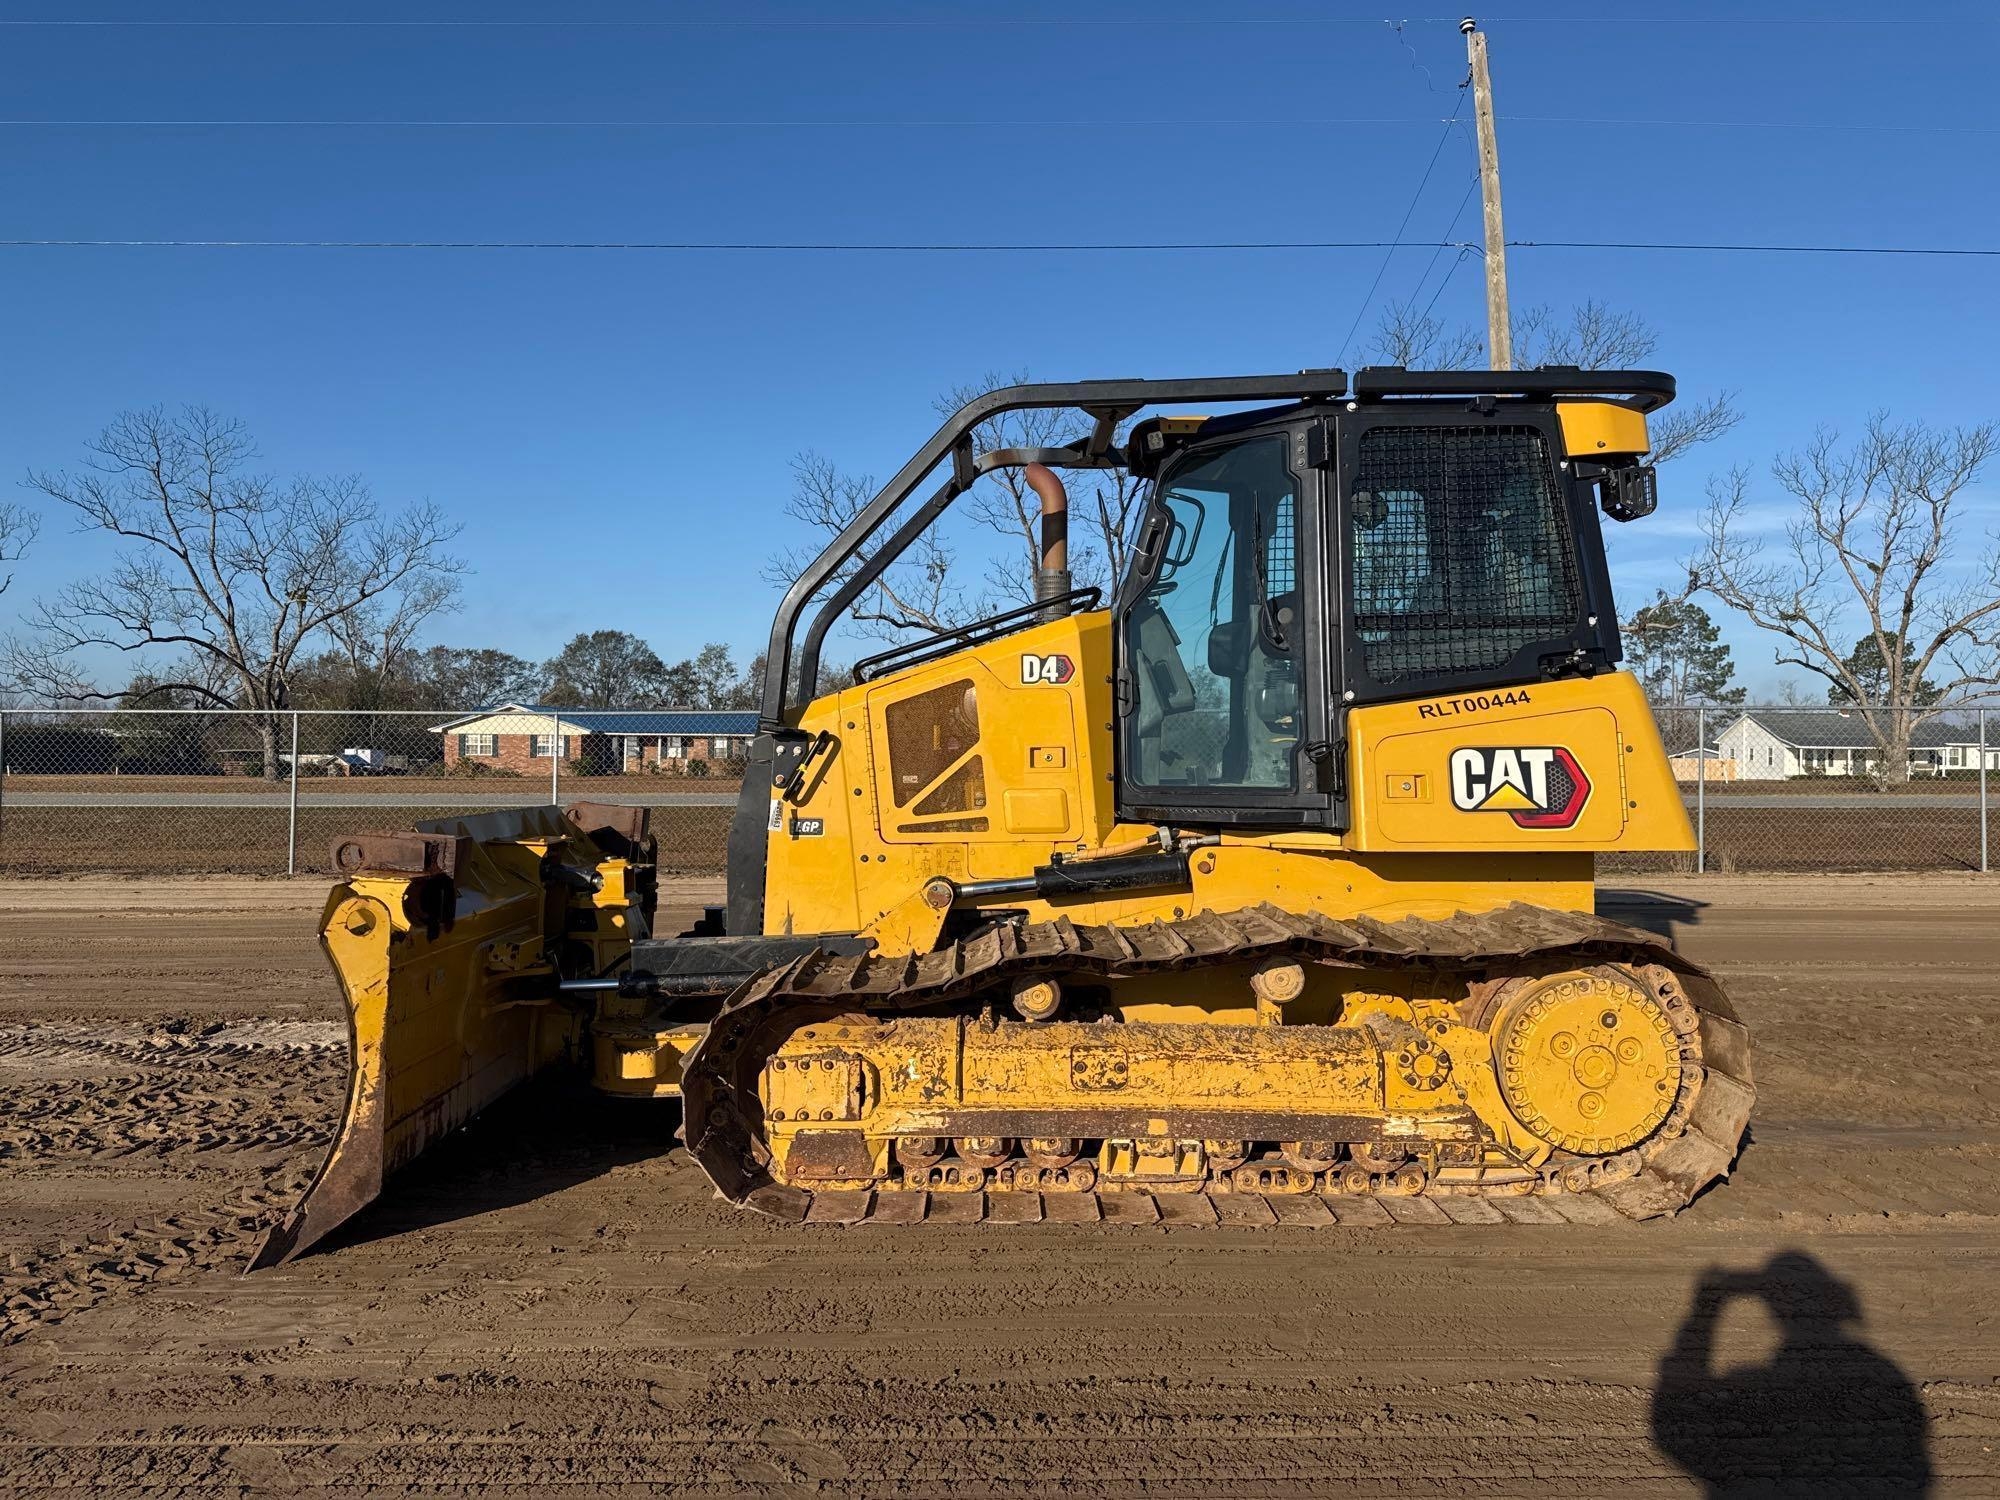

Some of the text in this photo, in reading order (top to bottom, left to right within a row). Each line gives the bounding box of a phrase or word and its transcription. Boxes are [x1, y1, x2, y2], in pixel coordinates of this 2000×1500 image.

[1022, 655, 1058, 682] D4
[1418, 690, 1531, 719] RLT00444
[1452, 749, 1554, 810] CAT
